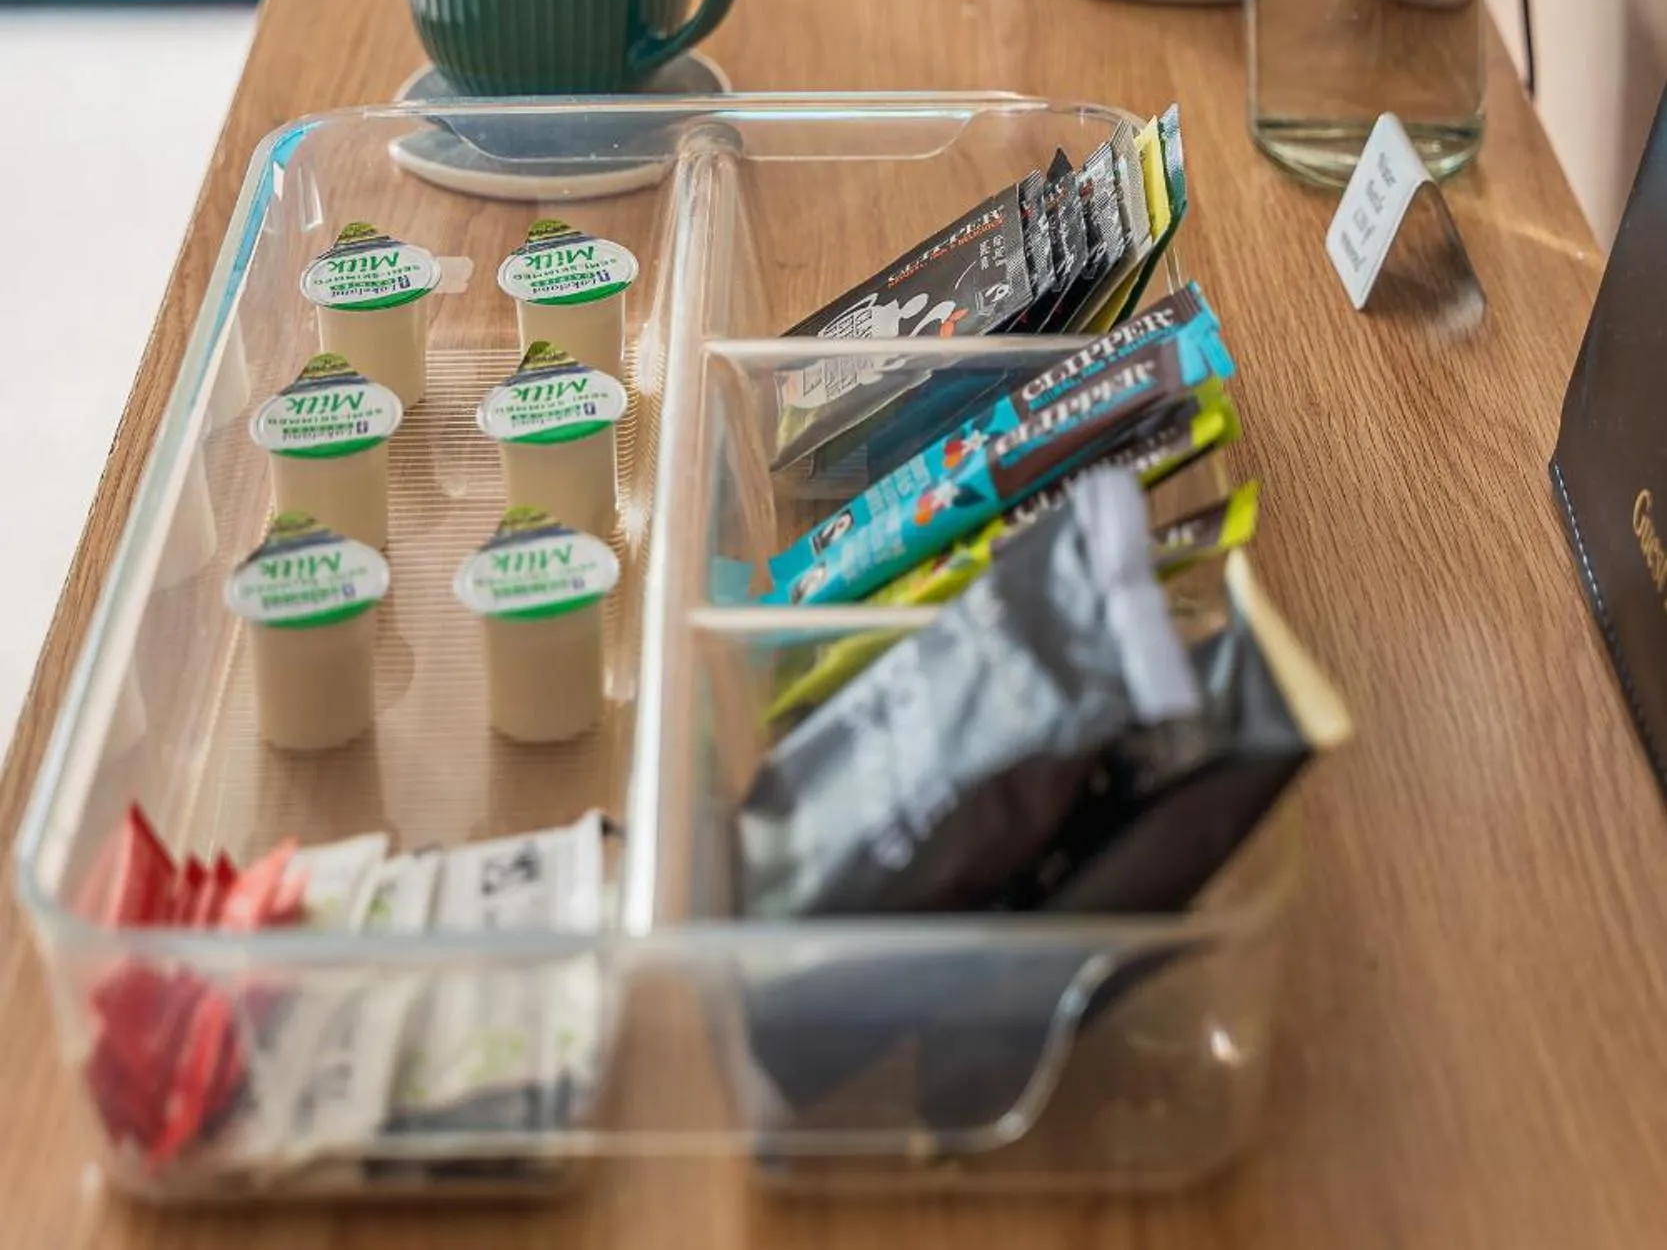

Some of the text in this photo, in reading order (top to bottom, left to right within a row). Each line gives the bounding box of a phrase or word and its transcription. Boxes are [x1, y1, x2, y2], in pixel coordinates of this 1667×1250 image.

[327, 251, 399, 273] Milk
[524, 245, 594, 270] Milk
[1021, 307, 1175, 402] CLIPPER
[285, 391, 364, 414] Milk
[511, 378, 588, 402] Milk
[259, 551, 341, 579] Milk
[490, 542, 572, 573] Milk
